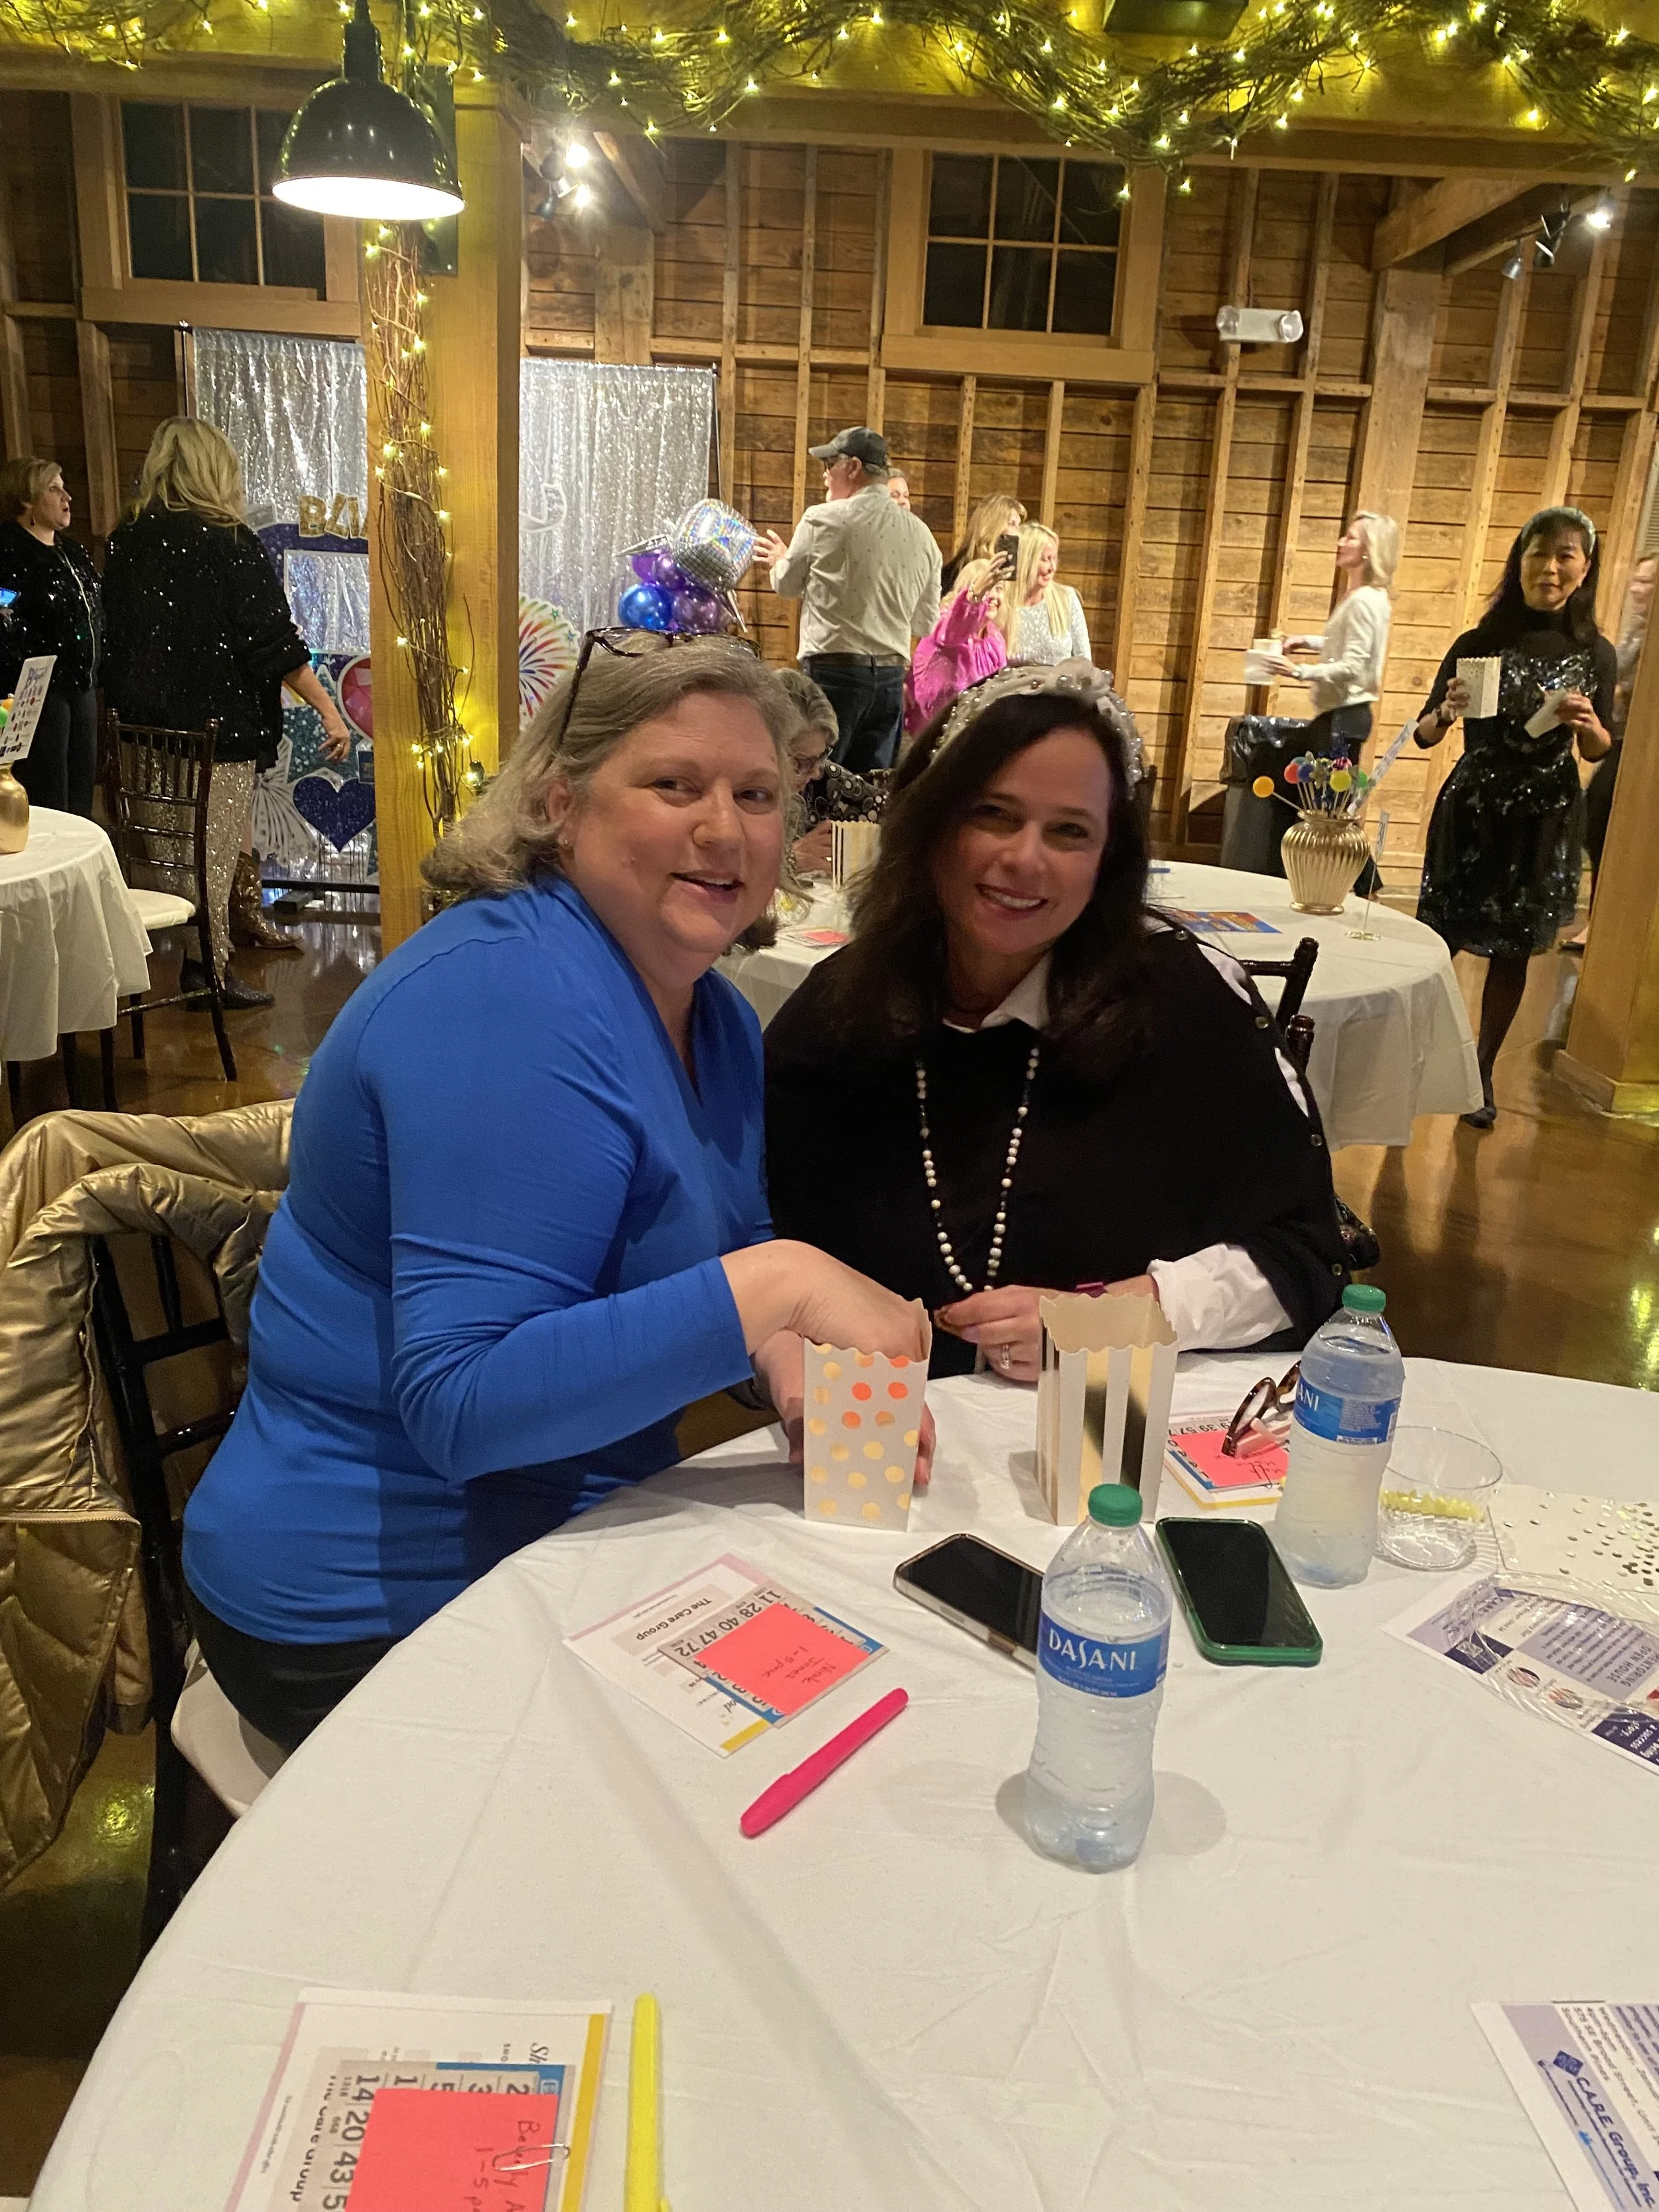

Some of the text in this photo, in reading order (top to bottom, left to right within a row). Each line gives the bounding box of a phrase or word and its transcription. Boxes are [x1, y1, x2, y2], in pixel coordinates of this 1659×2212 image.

[298, 490, 368, 540] BLI
[1299, 1383, 1319, 1411] ANI
[692, 1598, 712, 1610] The
[759, 1590, 781, 1604] 11
[668, 1608, 692, 1623] Care
[739, 1603, 762, 1618] 28
[636, 1622, 669, 1641] Group
[718, 1617, 739, 1631] 40
[699, 1630, 718, 1645] 47
[675, 1642, 699, 1657] 72
[1048, 1627, 1137, 1670] DASANI
[1607, 1645, 1652, 1682] OPEN HOUSE
[500, 2043, 512, 2063] SHO
[528, 2042, 549, 2063] Sh
[1561, 2006, 1611, 2081] Southern Pines
[352, 2075, 380, 2101] 14
[342, 2110, 370, 2142] 20
[1609, 2131, 1639, 2181] Group,
[330, 2151, 358, 2183] 43
[323, 2193, 348, 2211] 5
